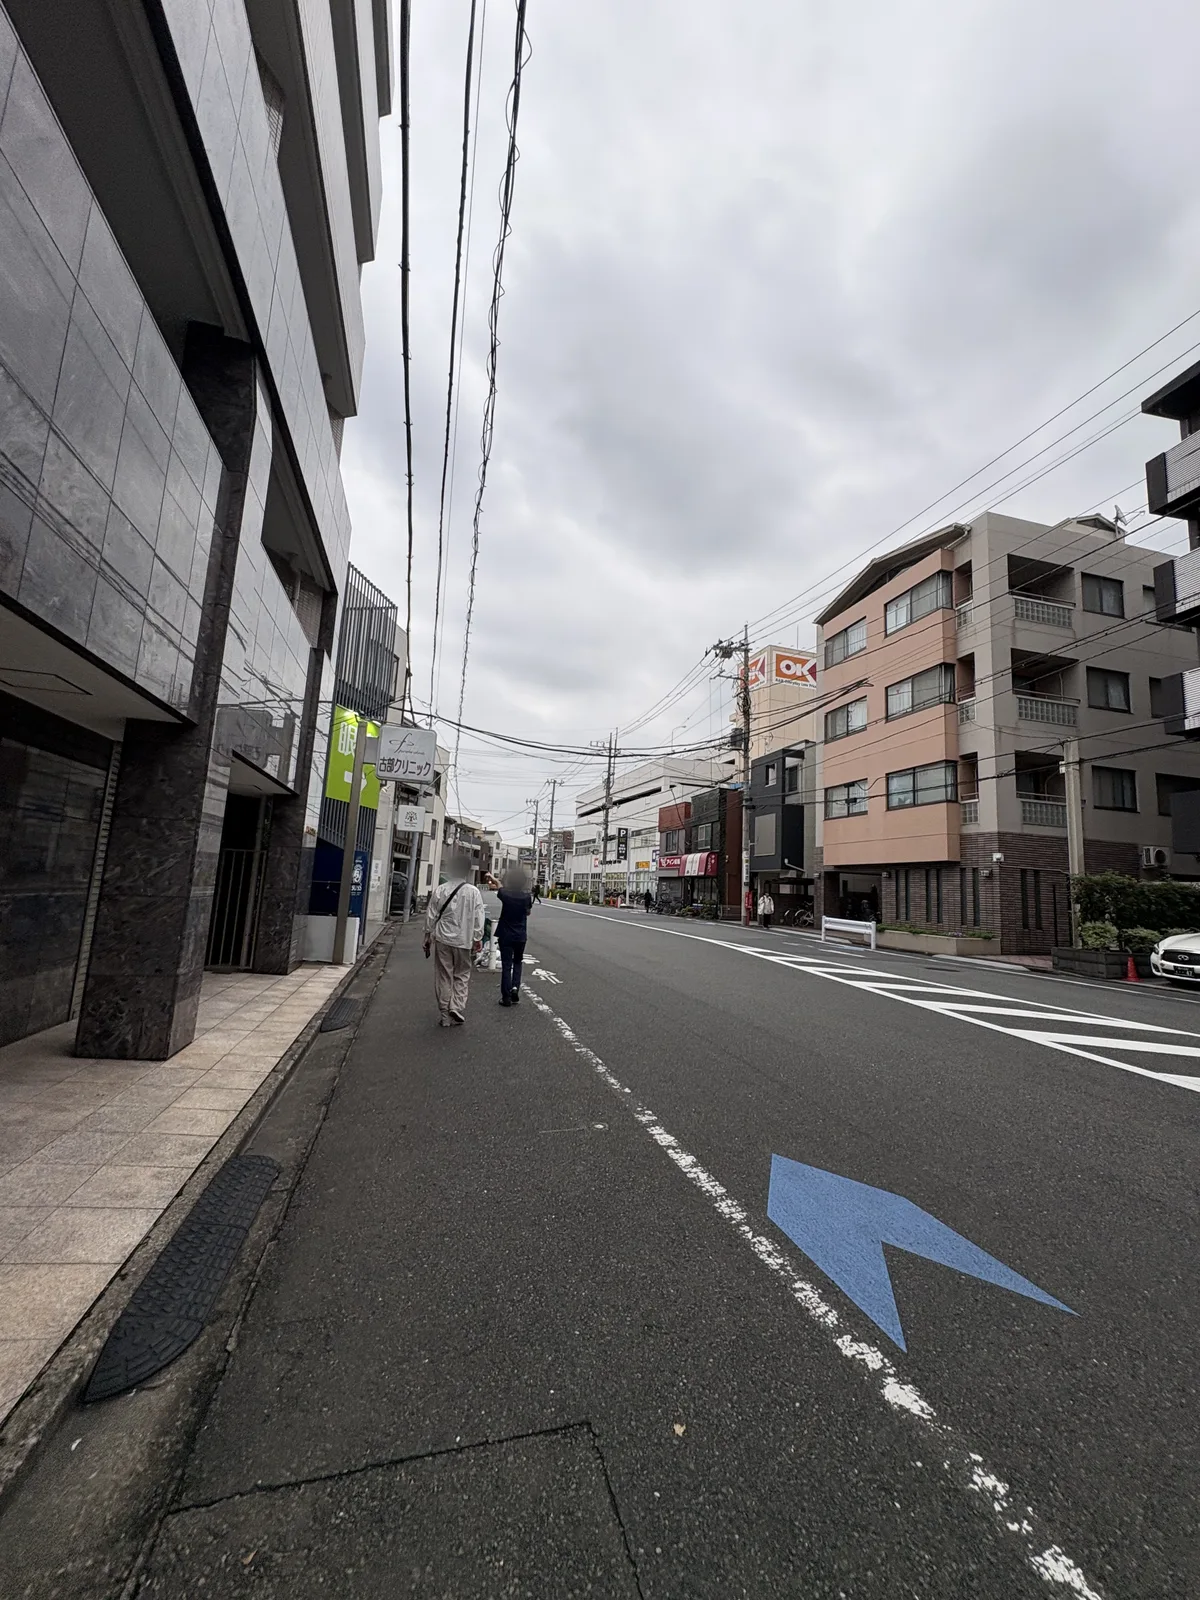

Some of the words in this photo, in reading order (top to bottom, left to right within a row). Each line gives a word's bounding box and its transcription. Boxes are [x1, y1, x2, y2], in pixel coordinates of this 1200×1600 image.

[780, 658, 817, 684] OK
[378, 756, 431, 776] 古部クリニック
